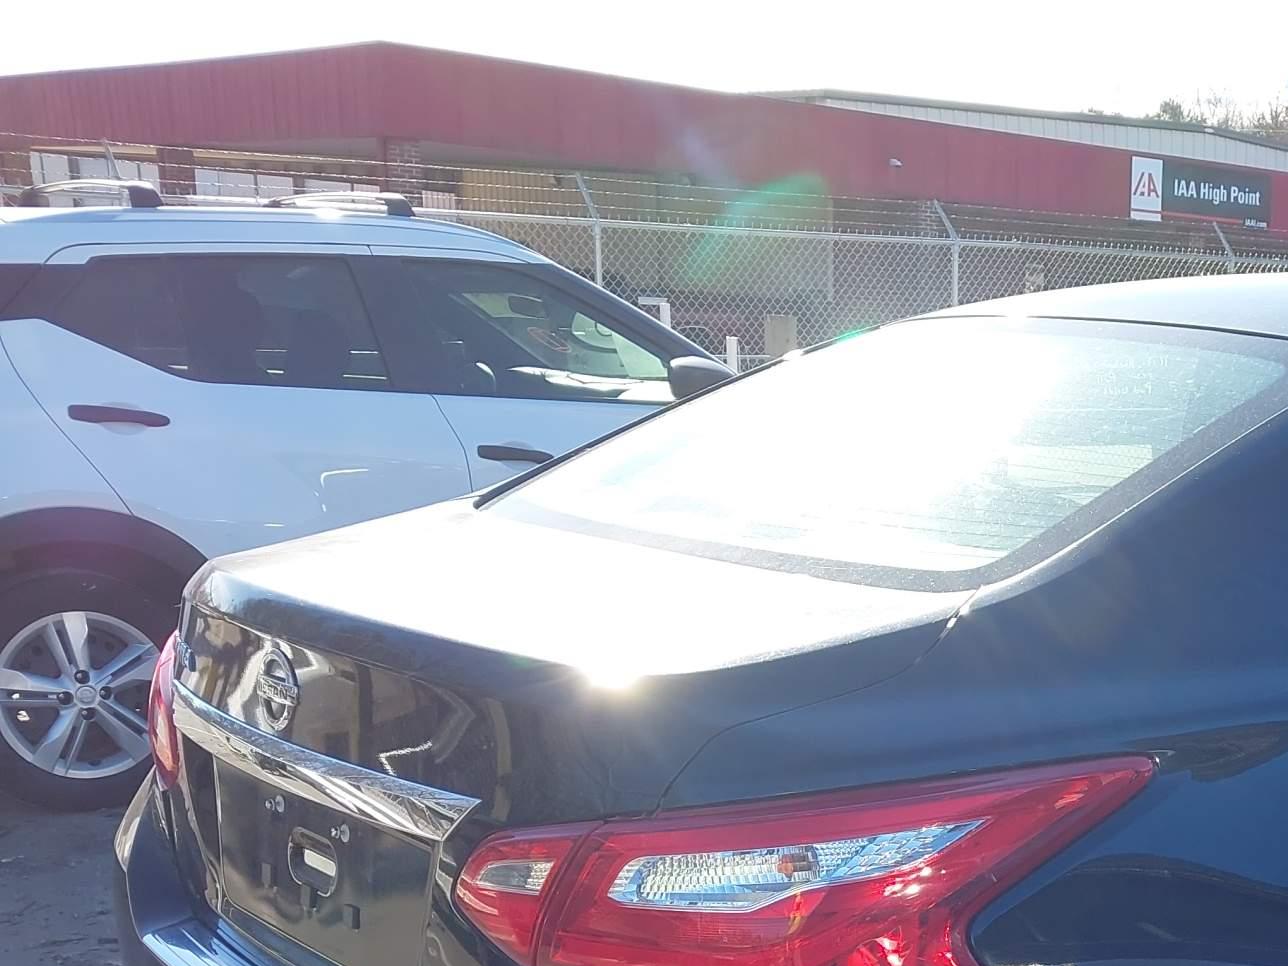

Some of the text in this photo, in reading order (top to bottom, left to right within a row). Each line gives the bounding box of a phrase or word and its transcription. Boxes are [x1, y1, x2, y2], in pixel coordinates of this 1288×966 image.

[1174, 178, 1261, 206] IAA High Point
